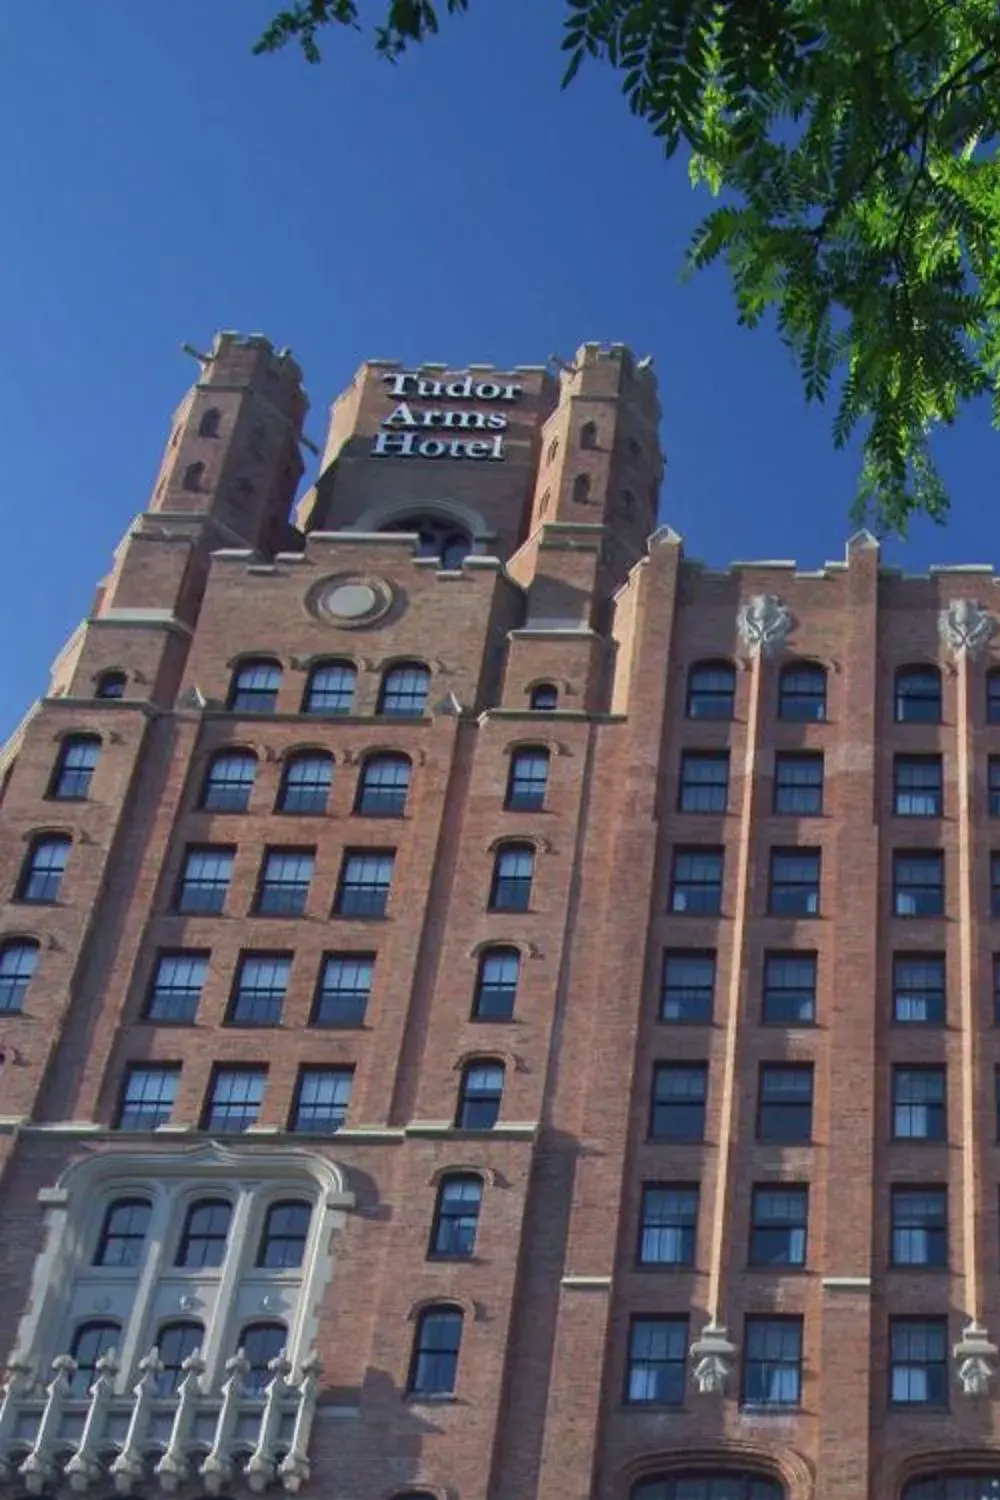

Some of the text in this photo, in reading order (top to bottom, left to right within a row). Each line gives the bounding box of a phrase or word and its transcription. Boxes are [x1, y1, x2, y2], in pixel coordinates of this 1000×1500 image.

[382, 373, 522, 400] Tudor
[382, 402, 508, 429] Arms
[370, 431, 504, 460] Hotel
